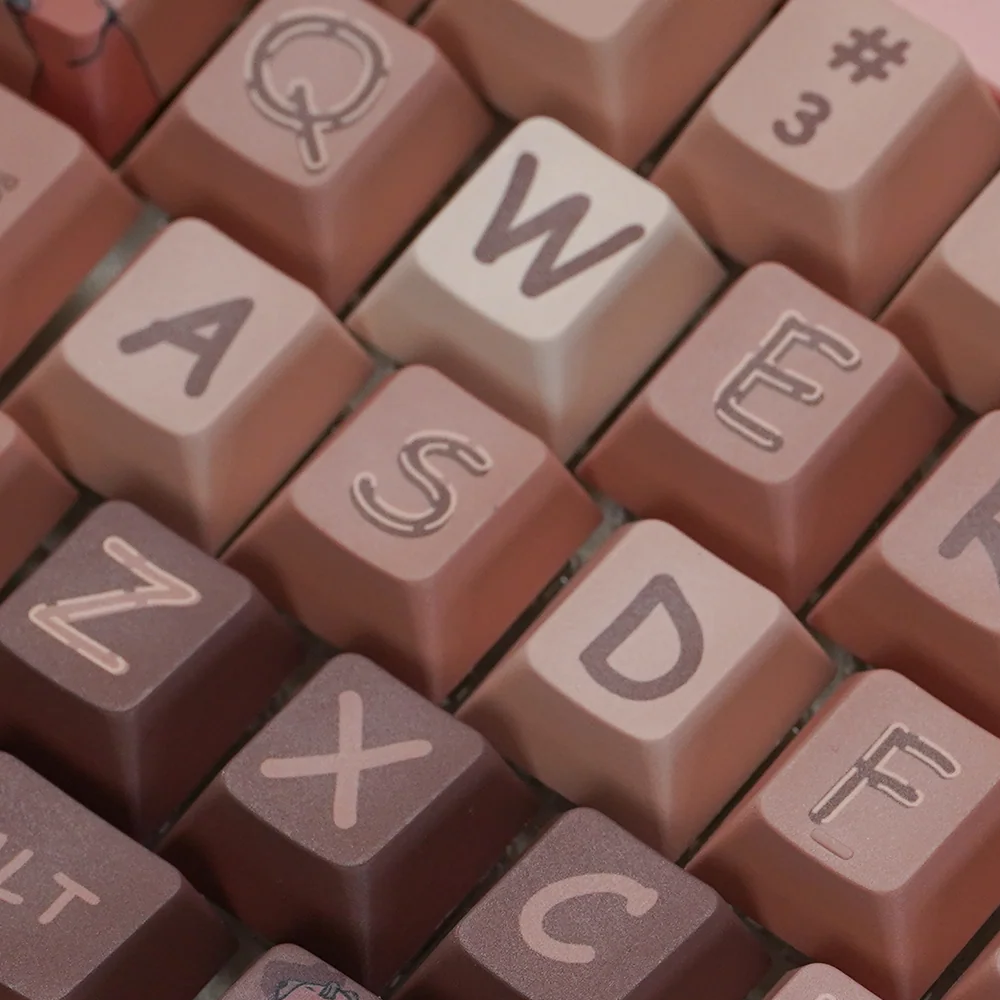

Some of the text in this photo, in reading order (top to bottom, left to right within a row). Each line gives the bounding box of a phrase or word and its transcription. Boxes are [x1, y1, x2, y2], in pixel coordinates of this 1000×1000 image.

[244, 13, 391, 173] Q
[828, 24, 910, 85] #
[772, 91, 832, 147] 3
[472, 152, 646, 299] W
[118, 297, 256, 398] A
[712, 309, 863, 454] E
[350, 430, 493, 539] S
[28, 535, 203, 677] Z
[579, 573, 704, 701] D
[259, 689, 433, 830] X
[808, 722, 962, 826] F
[518, 872, 659, 964] C
